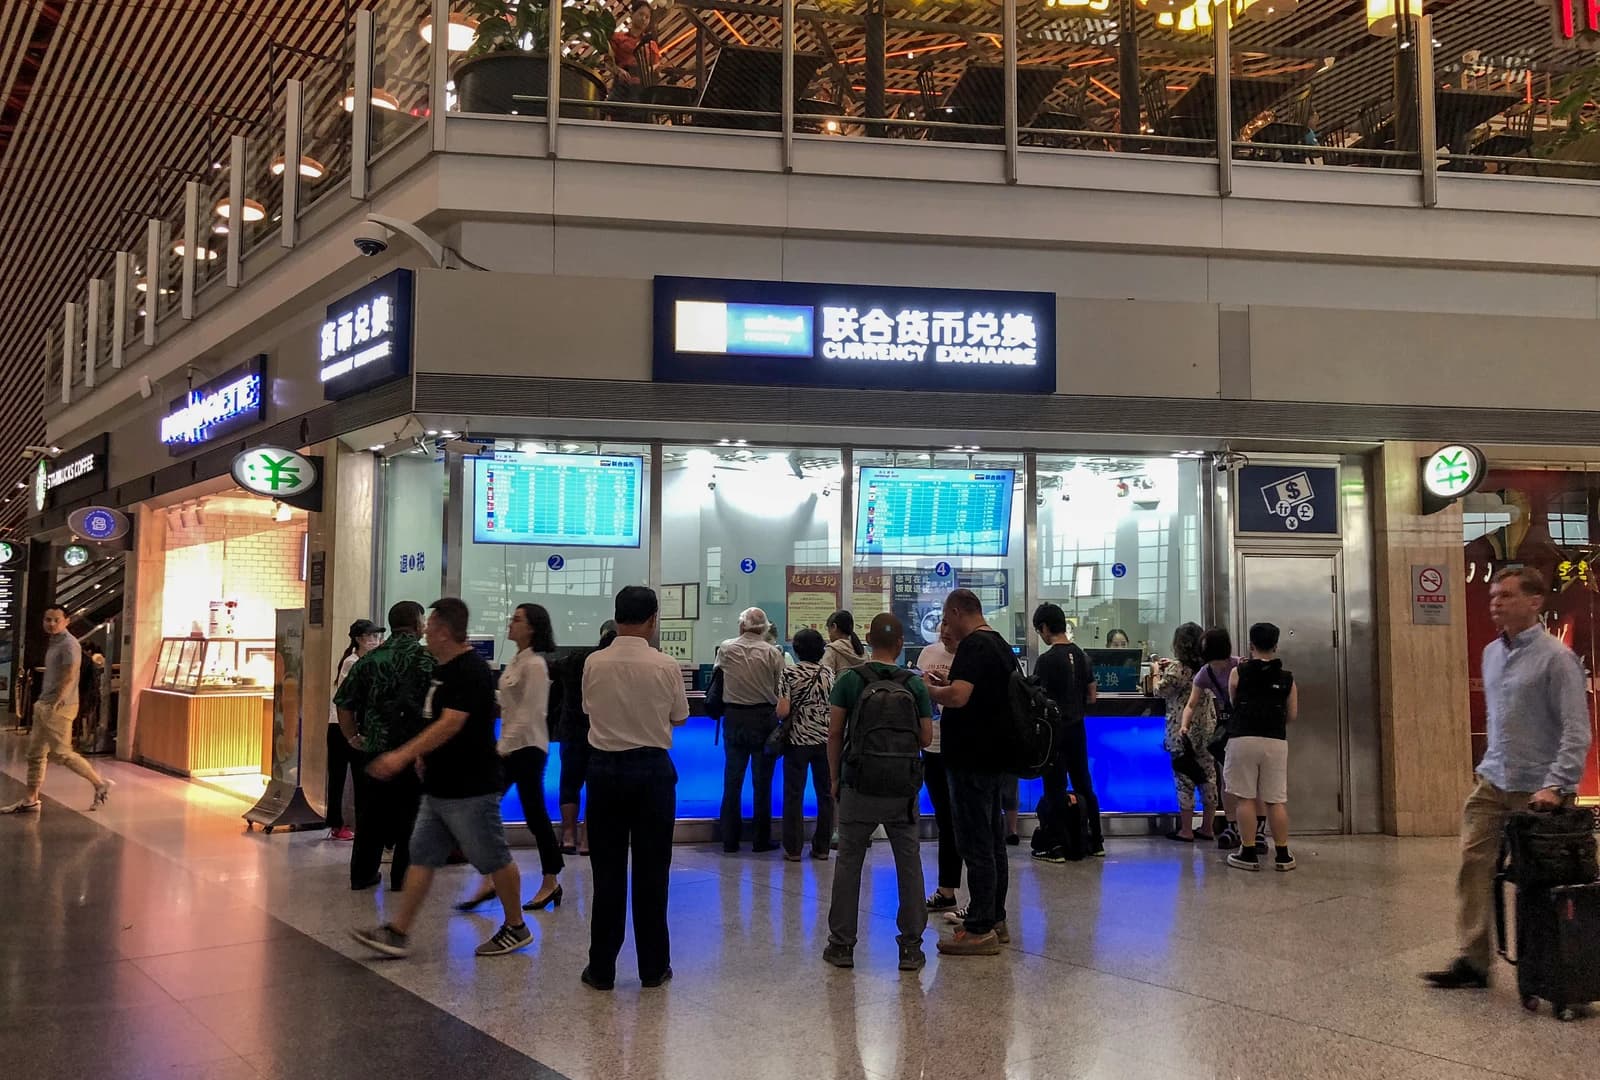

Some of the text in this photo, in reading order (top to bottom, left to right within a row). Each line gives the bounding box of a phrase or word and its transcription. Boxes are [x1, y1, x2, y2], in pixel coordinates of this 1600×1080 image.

[822, 307, 1036, 347] 联合货币兑换
[822, 342, 1036, 365] CURRENCY EXCHANGE
[550, 554, 562, 570] 2
[743, 558, 755, 572] 3
[936, 562, 948, 576] 4
[1113, 564, 1124, 577] 5
